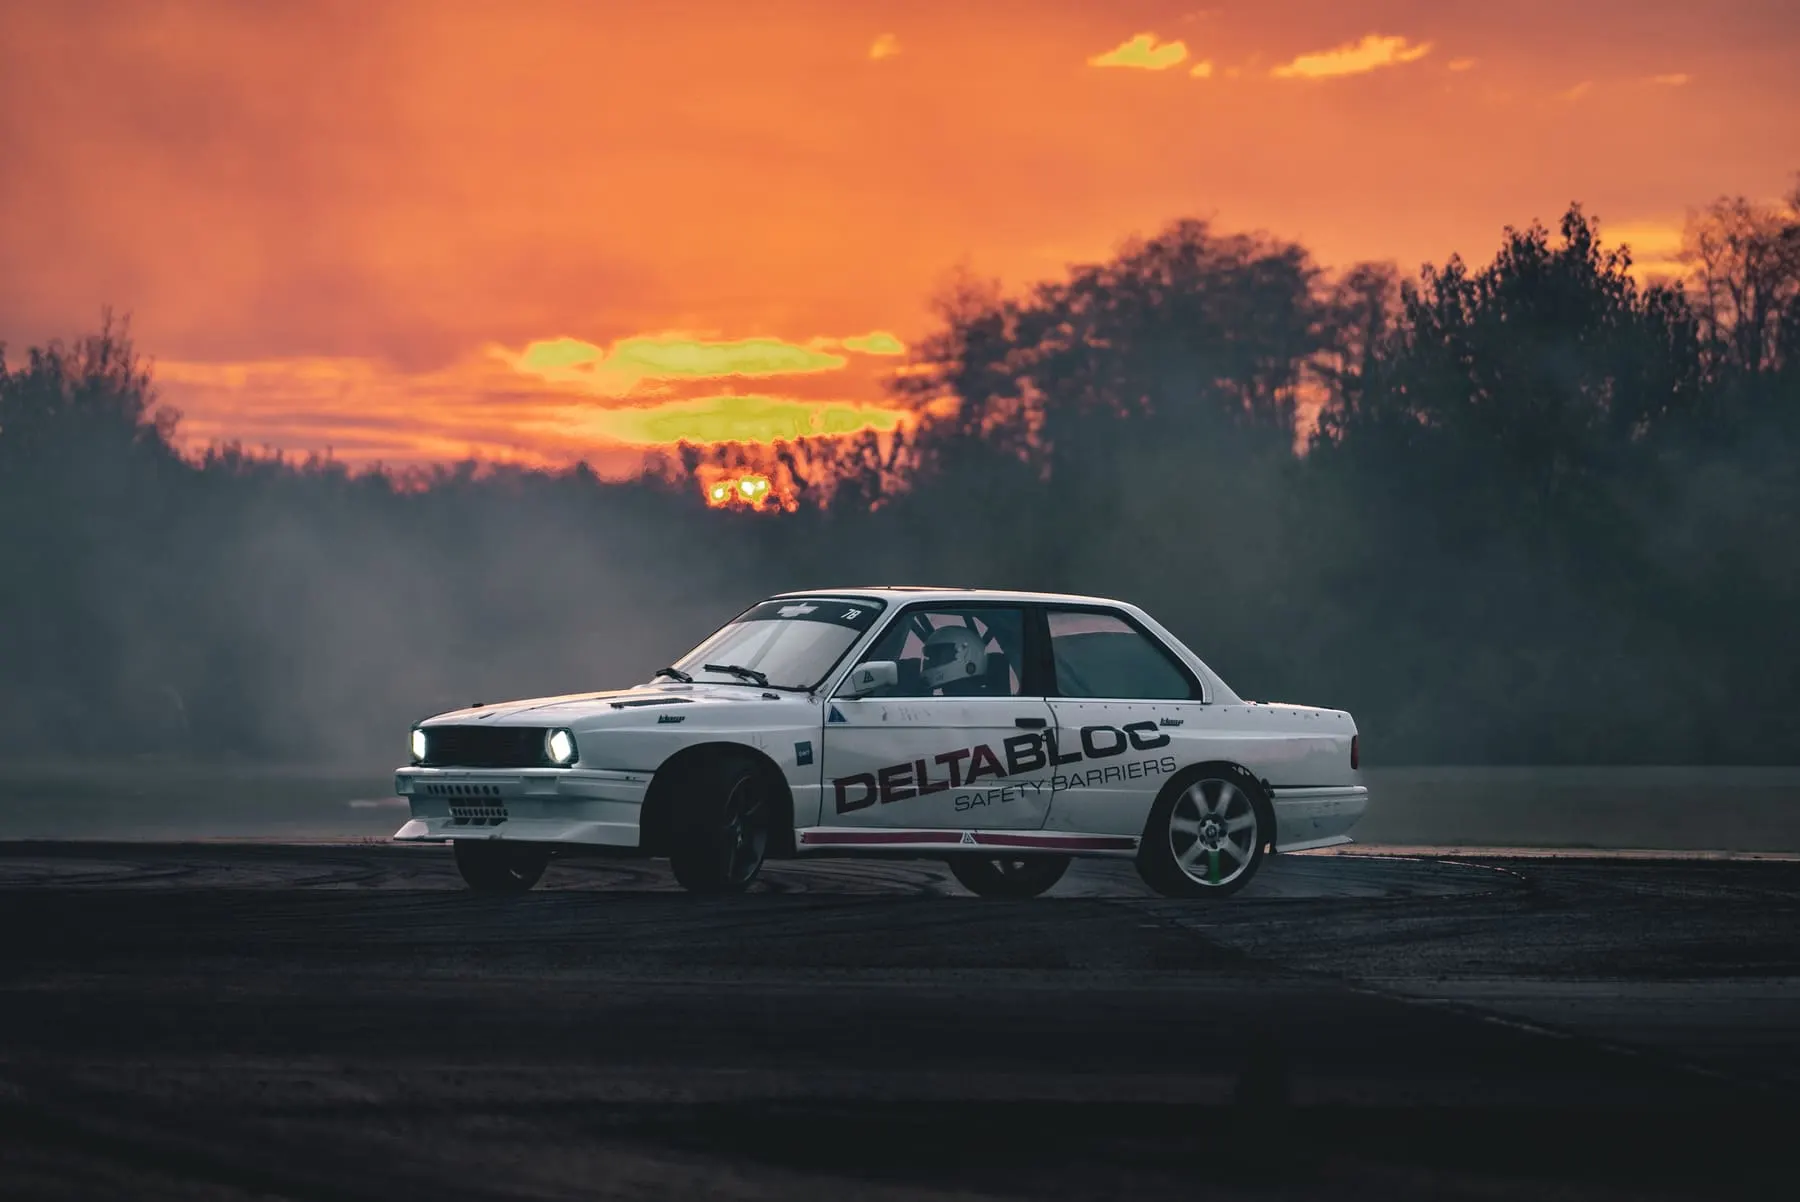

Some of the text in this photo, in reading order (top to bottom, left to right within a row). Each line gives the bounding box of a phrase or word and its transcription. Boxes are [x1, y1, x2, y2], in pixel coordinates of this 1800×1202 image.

[832, 720, 1171, 816] DELTABLOC
[954, 755, 1177, 812] SAFETY BARRIERS
